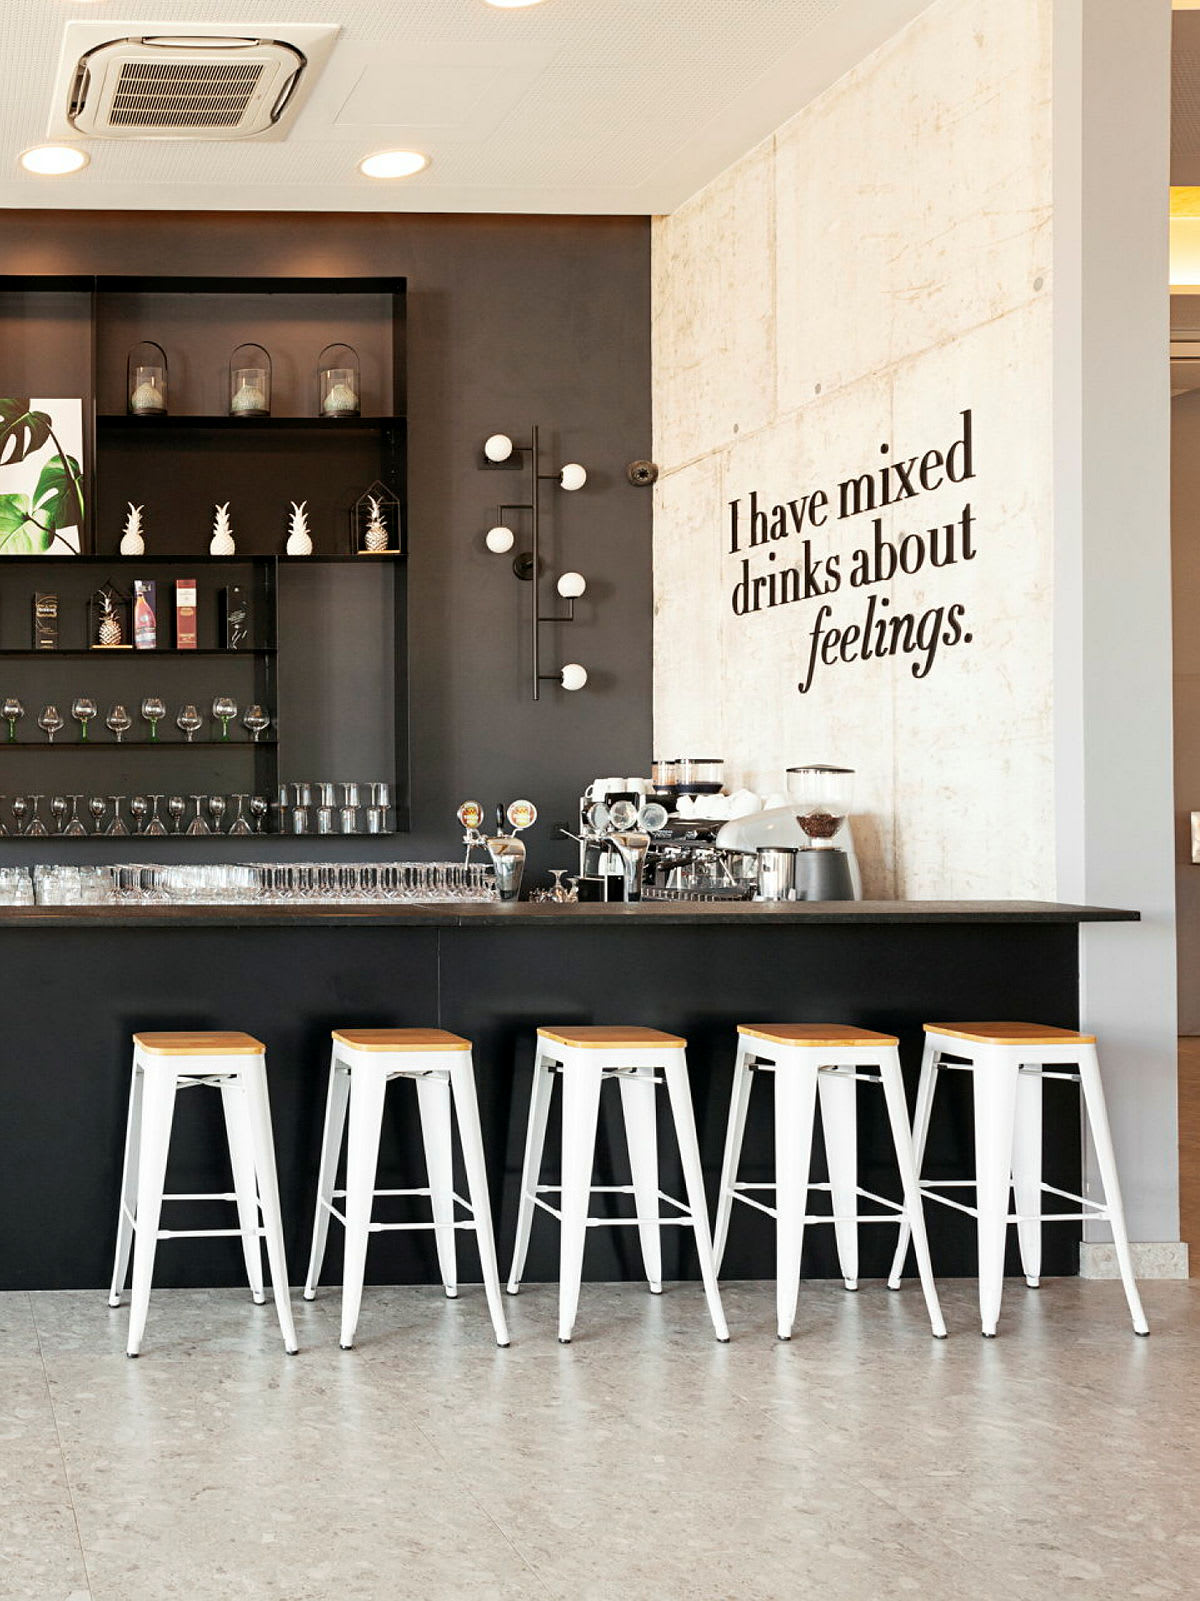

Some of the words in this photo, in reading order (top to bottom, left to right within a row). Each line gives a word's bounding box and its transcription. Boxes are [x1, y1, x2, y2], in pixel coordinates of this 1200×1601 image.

[728, 498, 741, 554] I
[748, 490, 828, 548] have
[837, 408, 976, 520] mixed
[731, 540, 841, 616] drinks
[850, 503, 977, 587] about
[798, 594, 973, 694] feelings.
